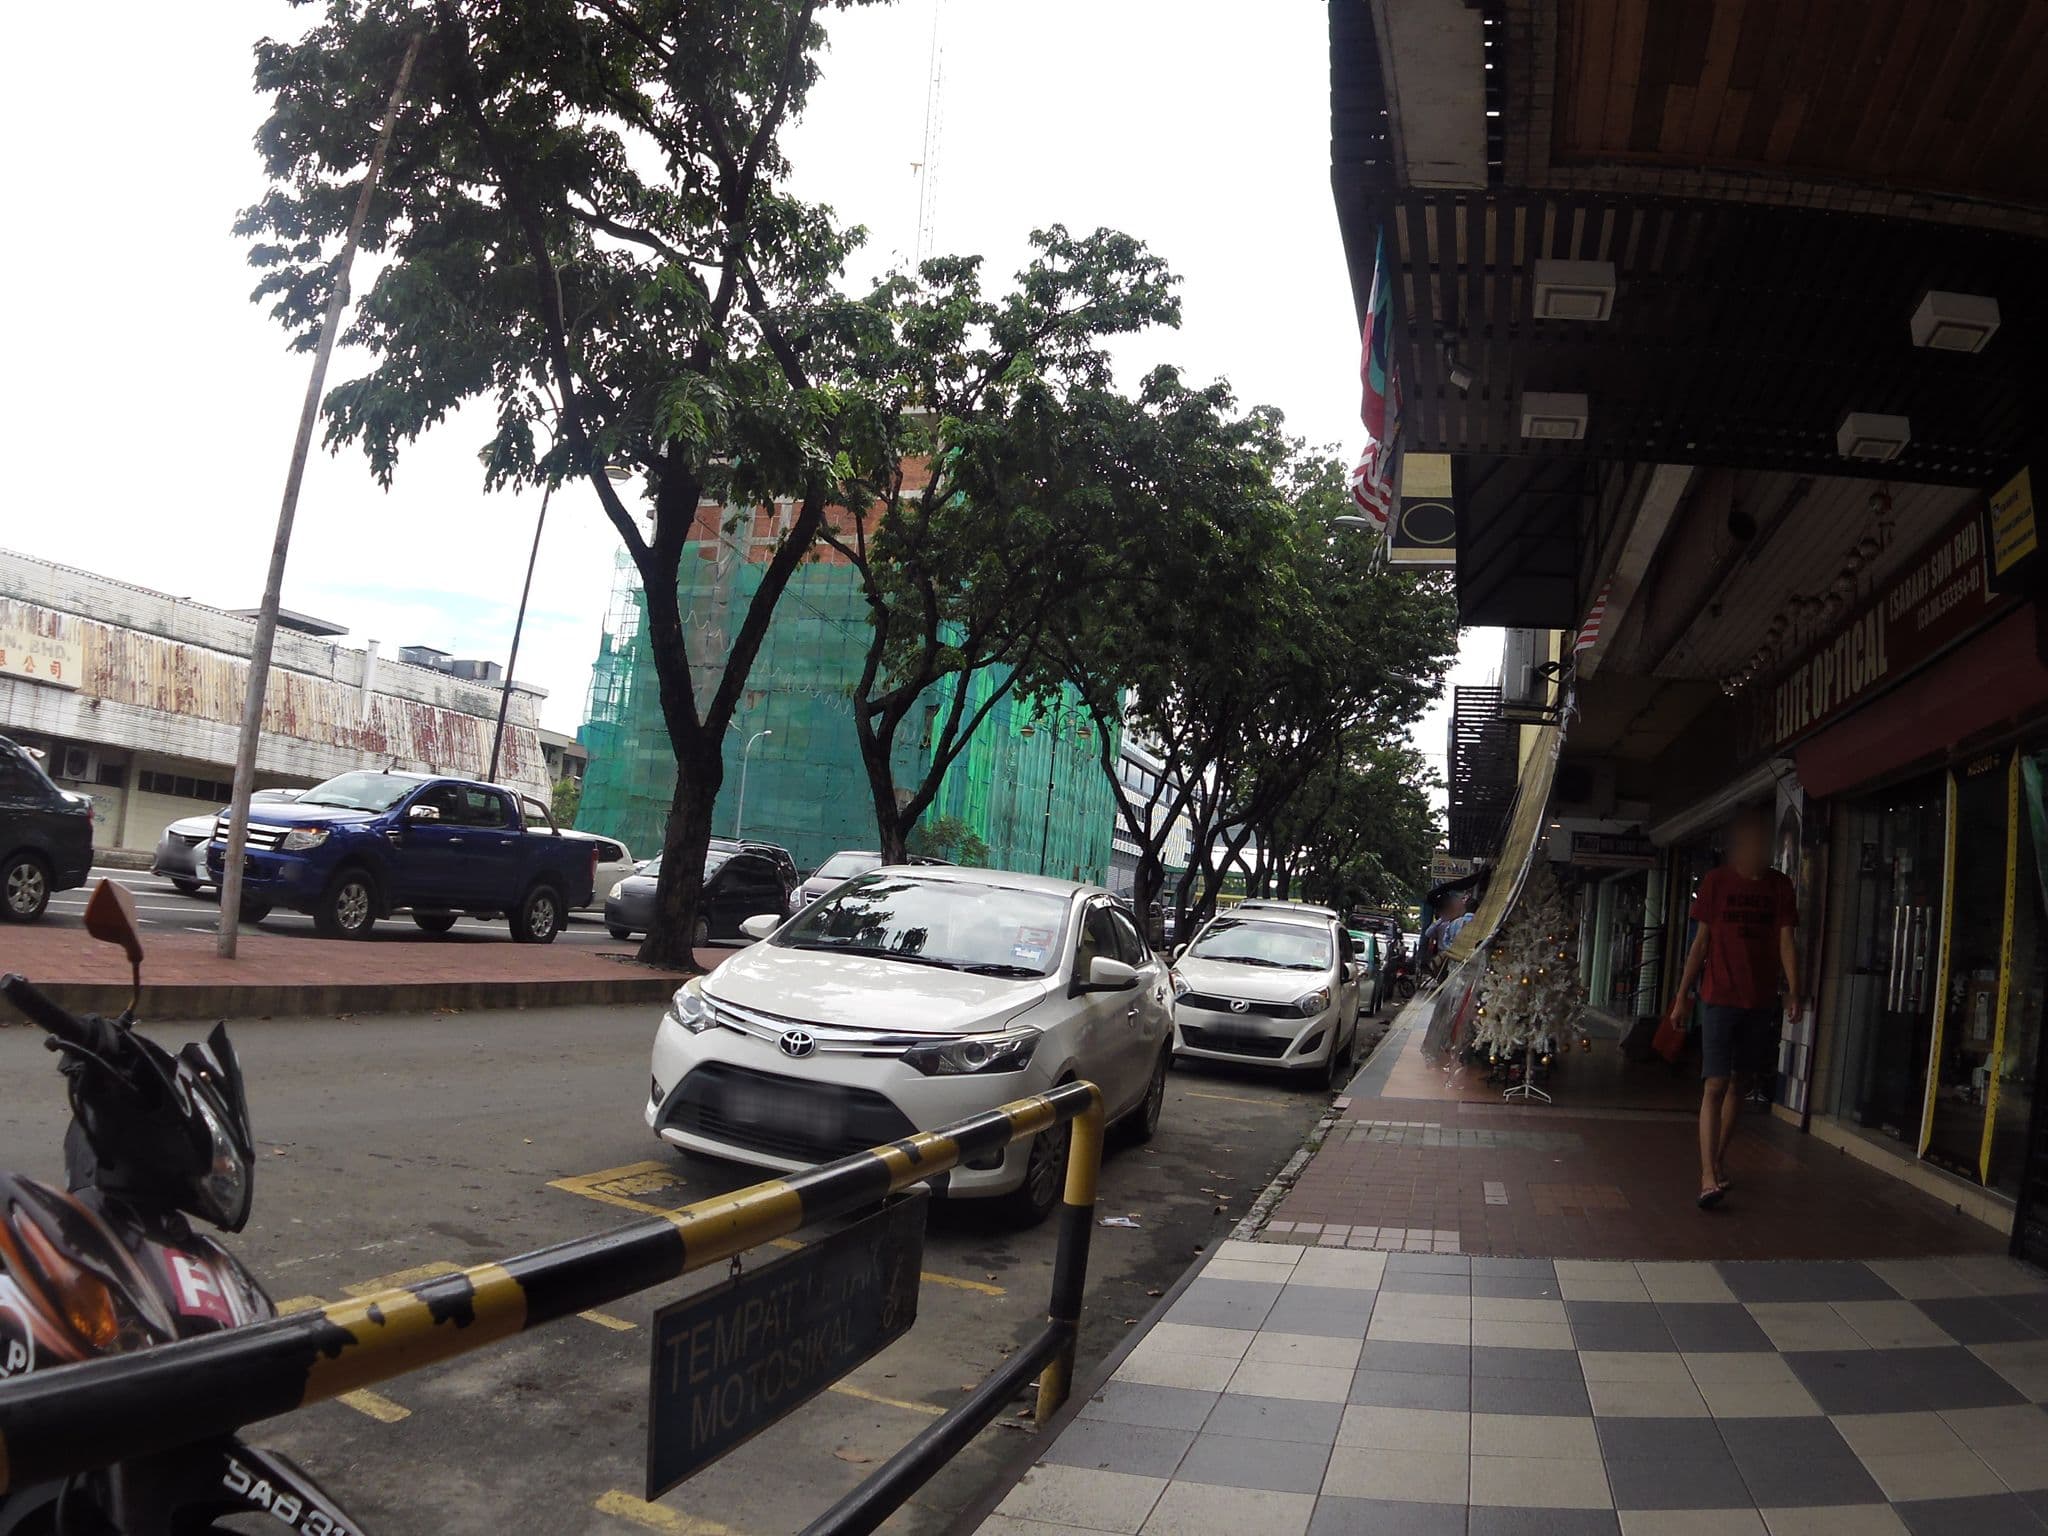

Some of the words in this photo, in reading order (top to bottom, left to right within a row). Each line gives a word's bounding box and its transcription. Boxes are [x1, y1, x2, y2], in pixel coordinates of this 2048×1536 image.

[1930, 541, 1952, 589] SDN
[1953, 520, 1978, 568] BHD
[1775, 664, 1809, 744] ELITE
[1811, 600, 1888, 720] OPTICAL
[666, 1280, 799, 1394] TEMPAT
[690, 1309, 855, 1447] MOTOSIKAL
